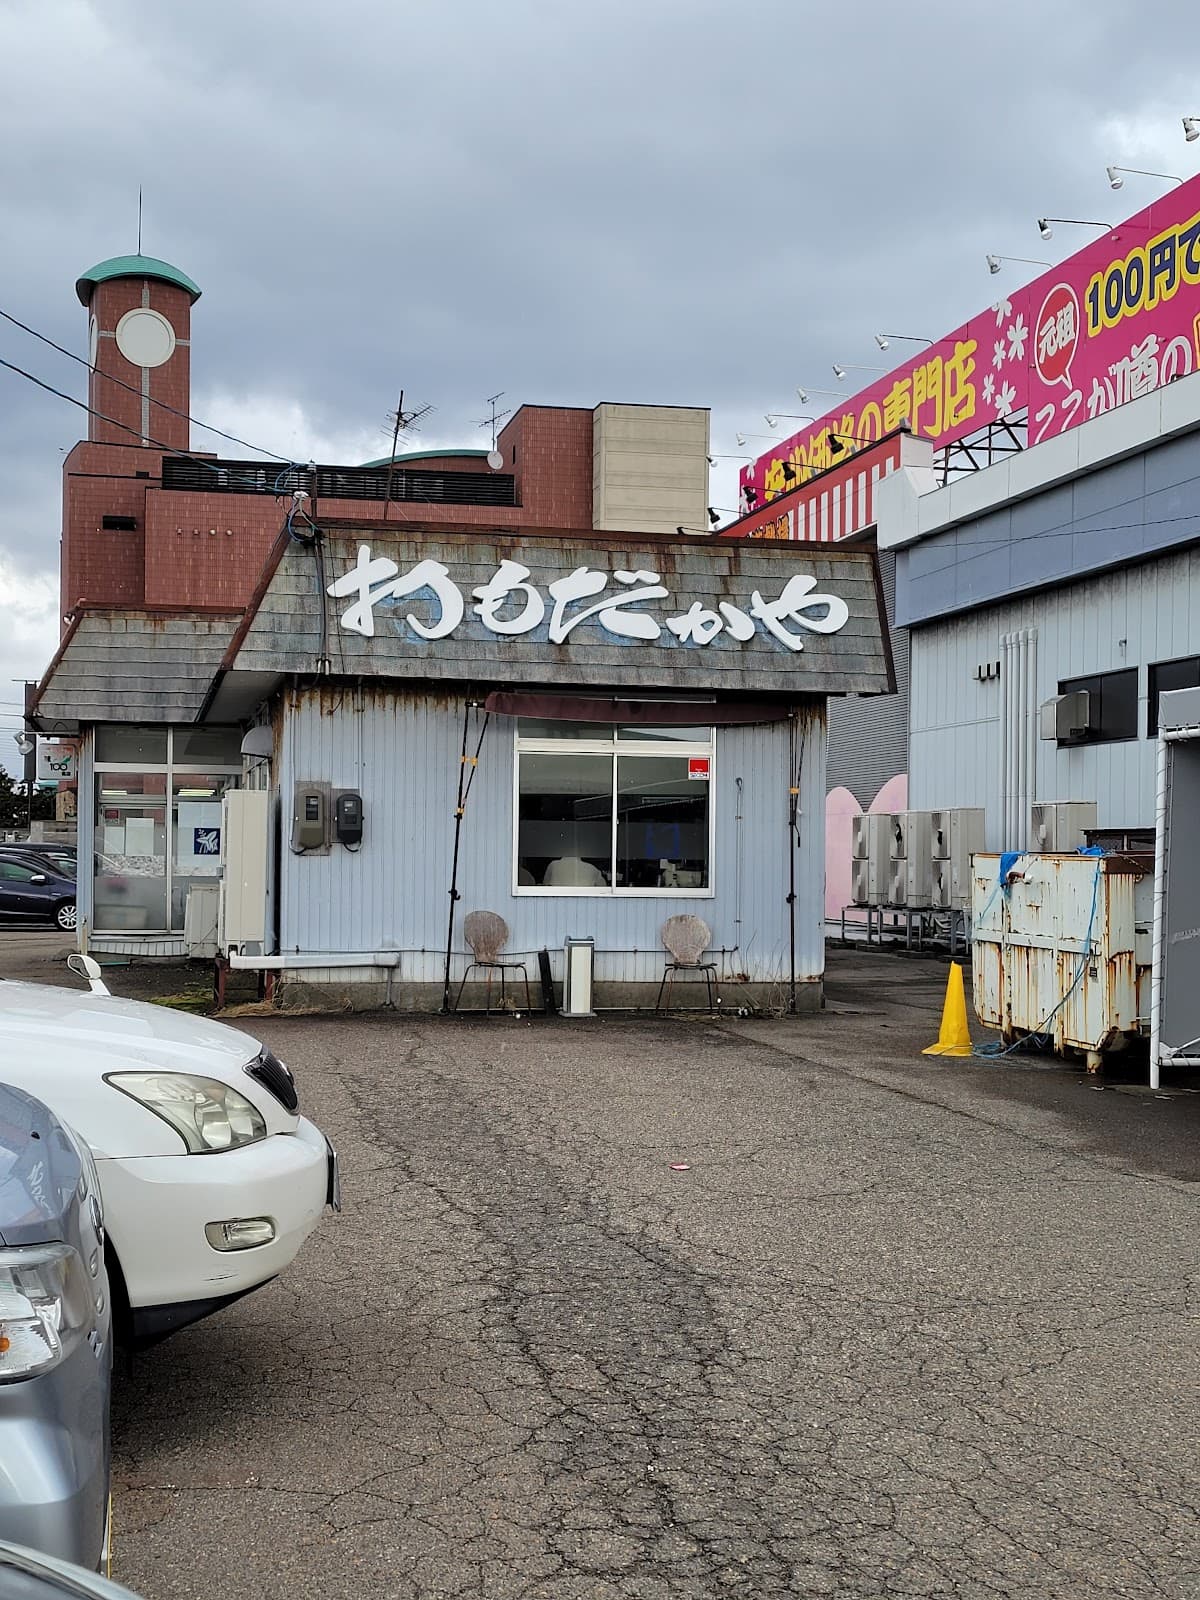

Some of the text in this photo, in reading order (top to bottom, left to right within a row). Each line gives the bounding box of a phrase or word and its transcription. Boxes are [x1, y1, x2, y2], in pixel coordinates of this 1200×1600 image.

[1039, 301, 1076, 364] 元祖
[328, 546, 849, 651] おもだかや
[50, 763, 68, 771] 100
